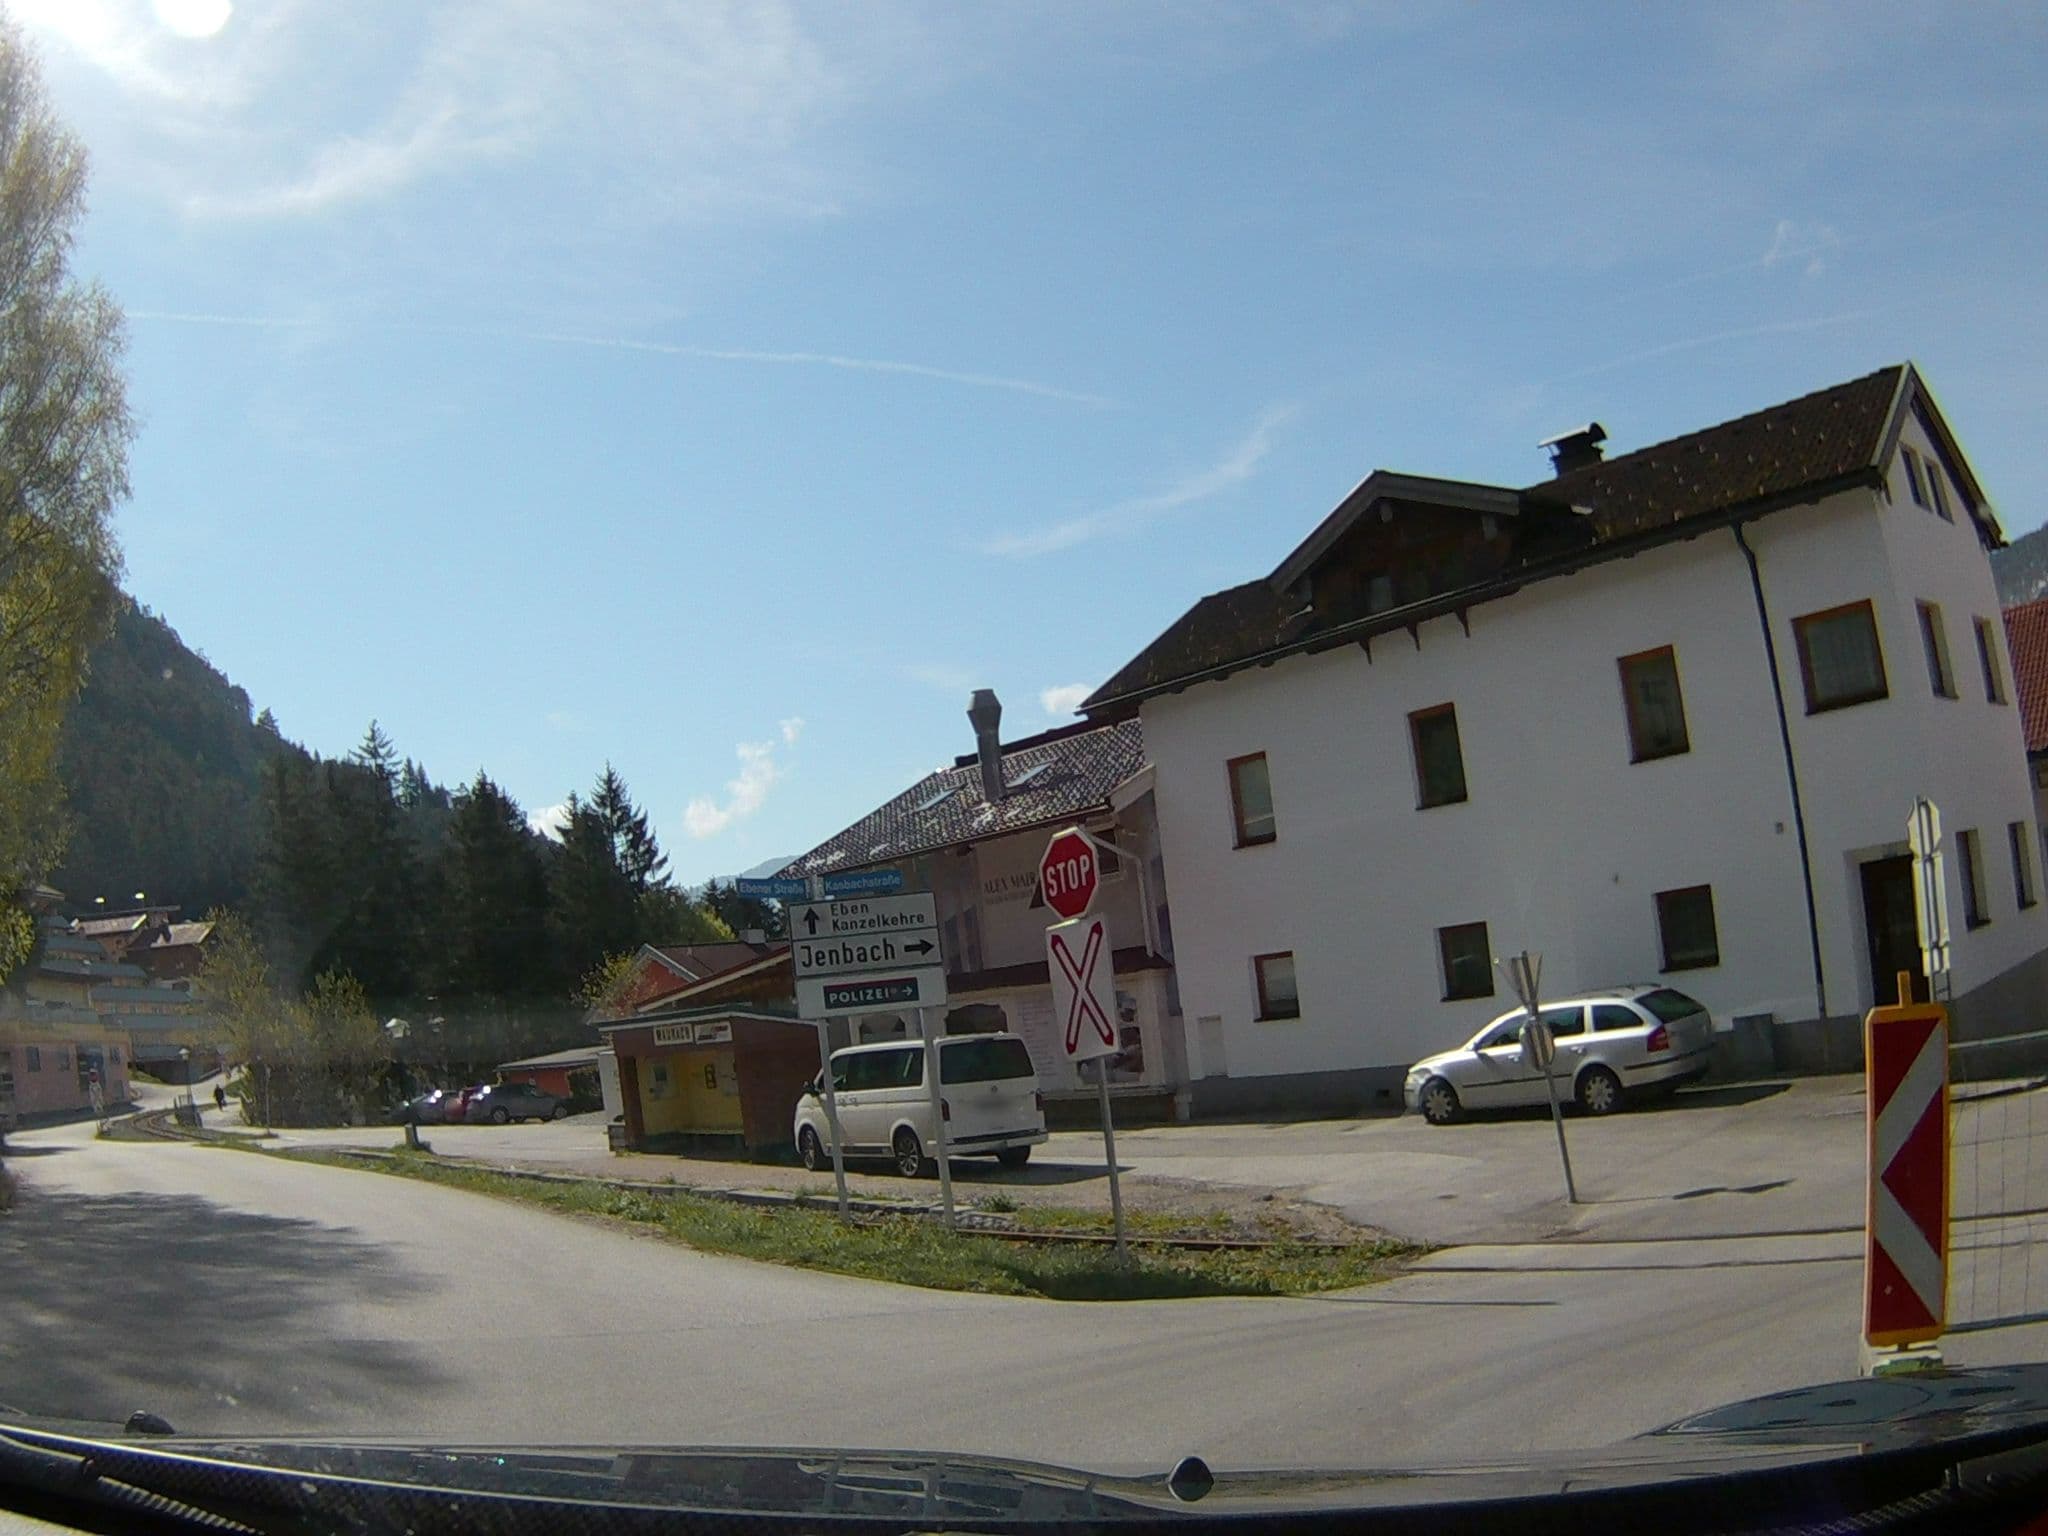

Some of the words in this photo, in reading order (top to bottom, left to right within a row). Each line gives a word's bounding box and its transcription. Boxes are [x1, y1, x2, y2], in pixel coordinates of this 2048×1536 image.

[1046, 854, 1090, 897] STOP
[774, 882, 804, 895] Straße
[830, 903, 869, 917] Eben
[832, 912, 925, 932] Kanzelkehre
[801, 937, 896, 968] Jenbach
[829, 987, 890, 1004] POLIZEI
